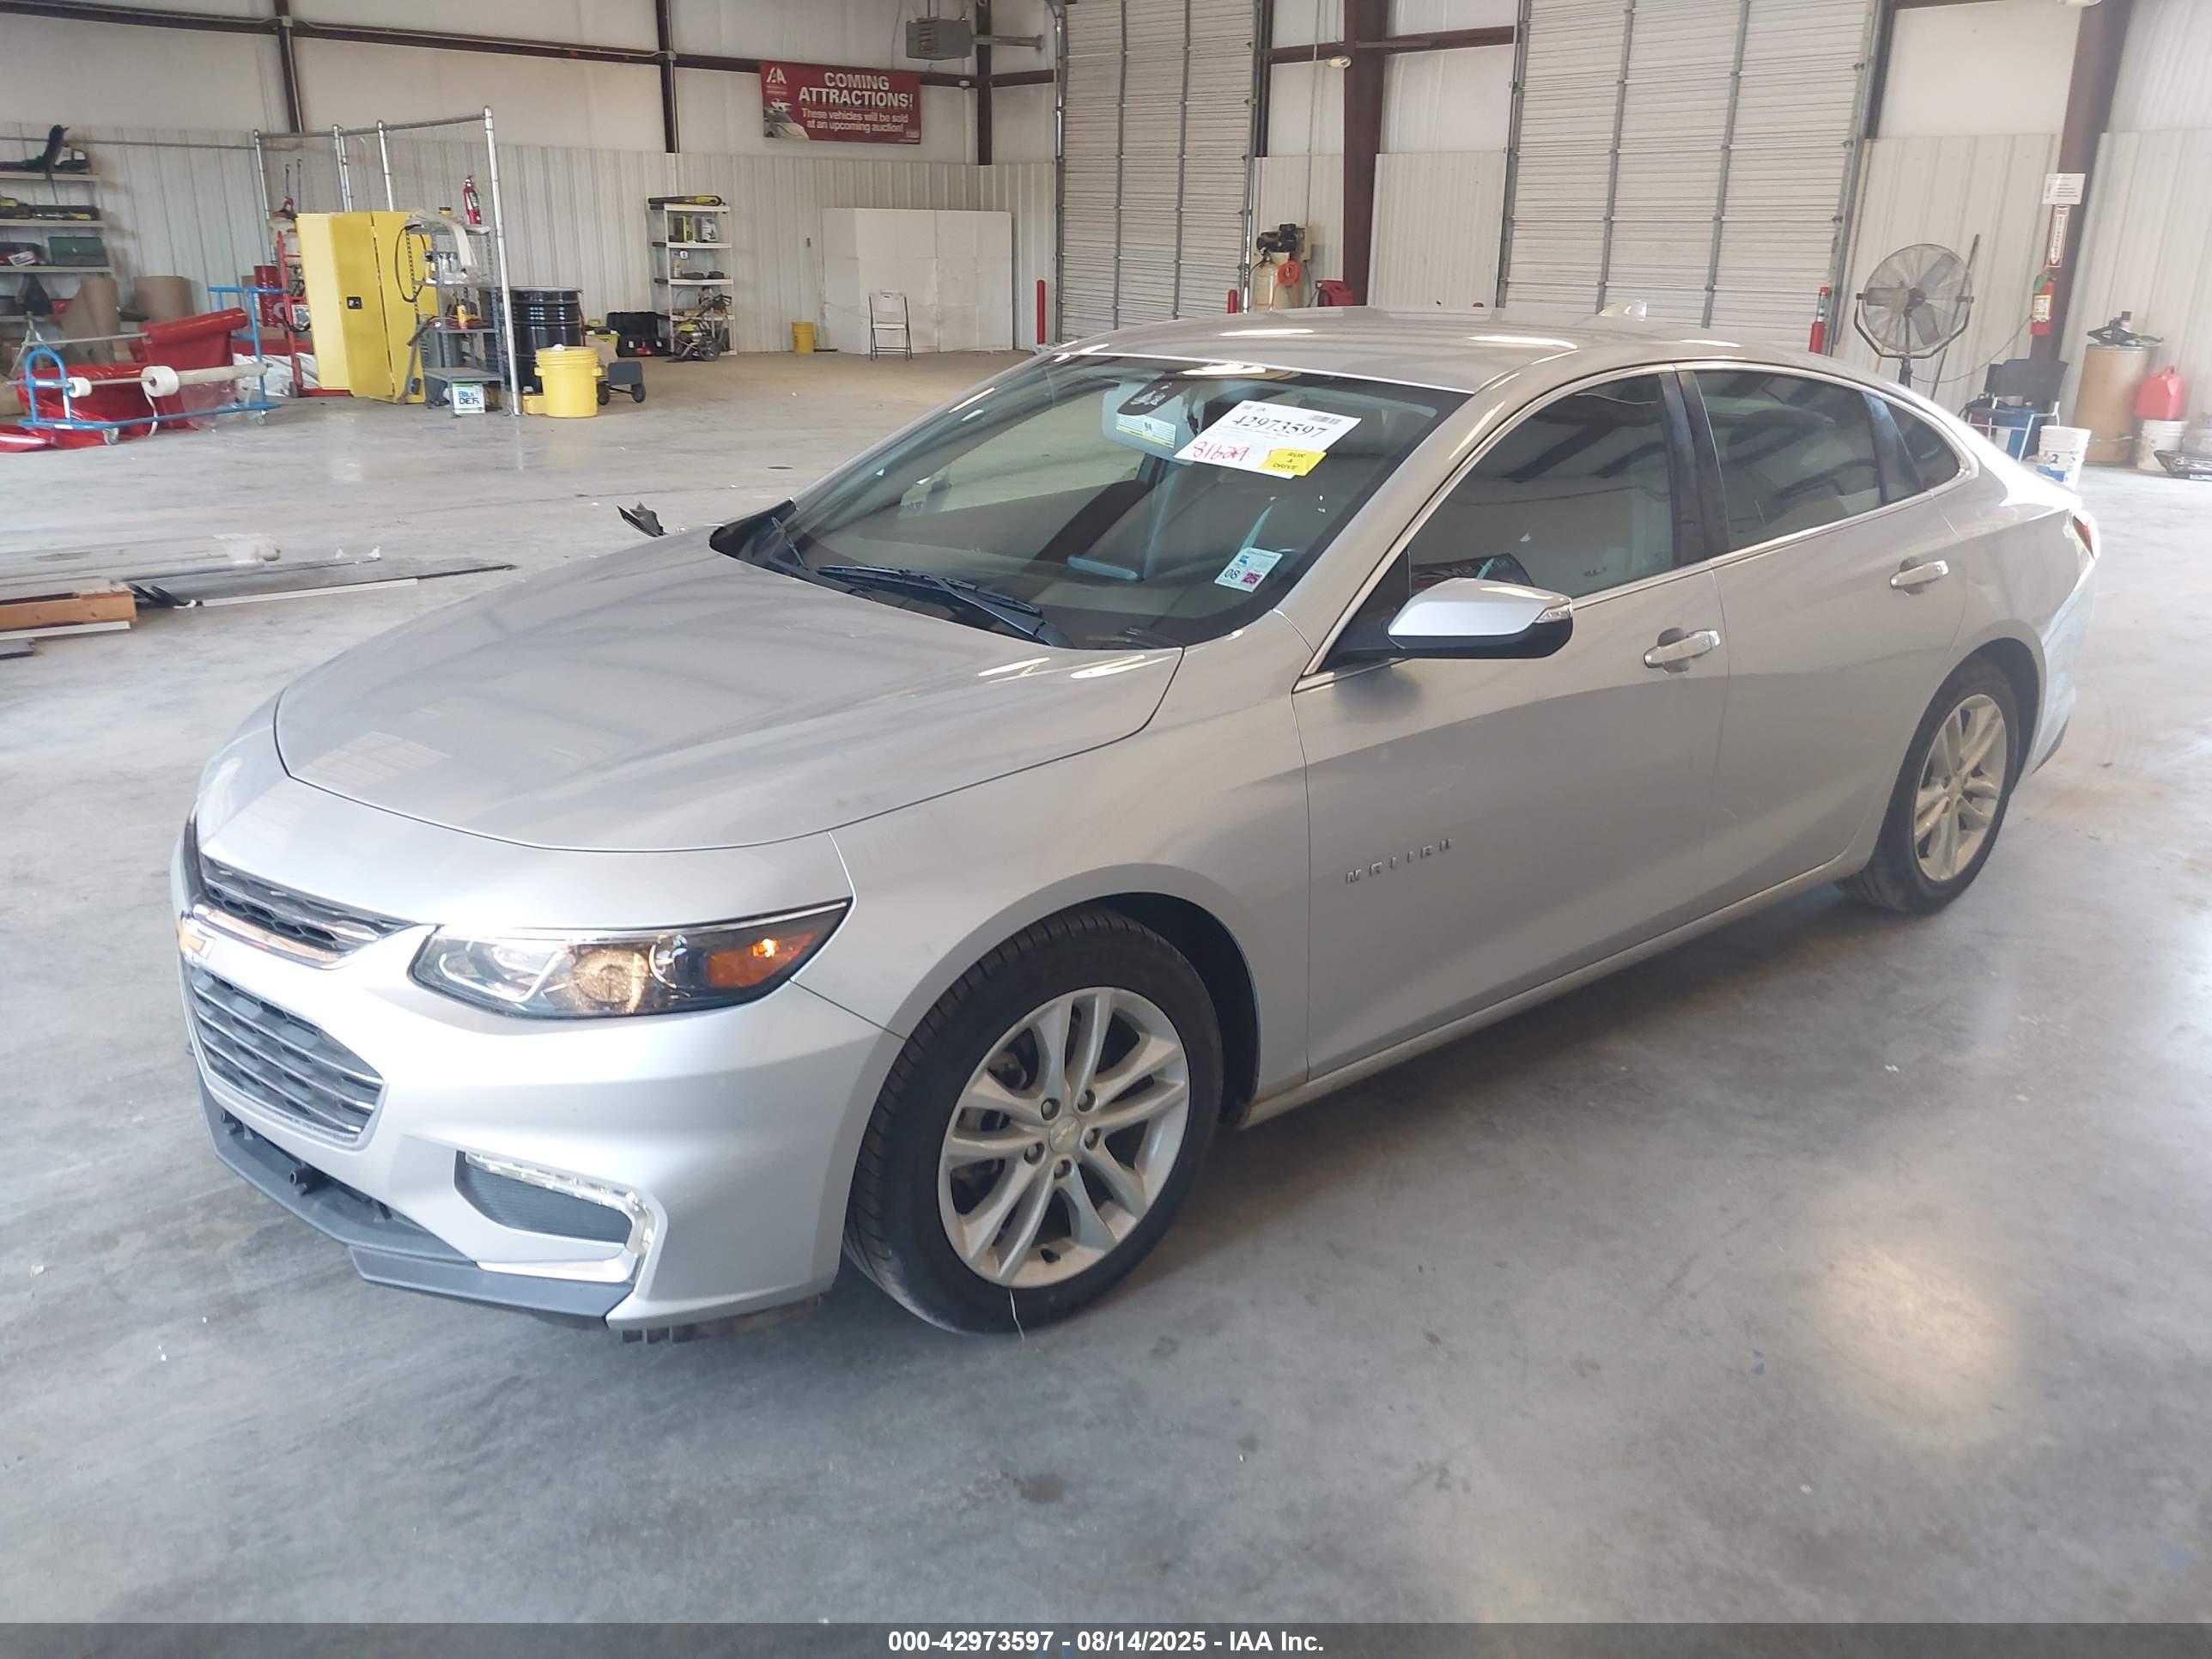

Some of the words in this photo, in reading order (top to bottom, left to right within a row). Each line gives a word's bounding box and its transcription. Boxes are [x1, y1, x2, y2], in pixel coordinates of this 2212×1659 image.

[823, 71, 890, 90] COMING
[798, 86, 914, 108] ATTRACTIONS!
[802, 107, 827, 119] These
[829, 110, 863, 121] vehicles
[864, 112, 878, 122] will
[878, 112, 890, 122] be
[891, 113, 908, 123] sold
[806, 119, 816, 129] at
[829, 121, 871, 133] upcoming
[872, 123, 904, 132] auction!
[1231, 415, 1328, 438] 42973597
